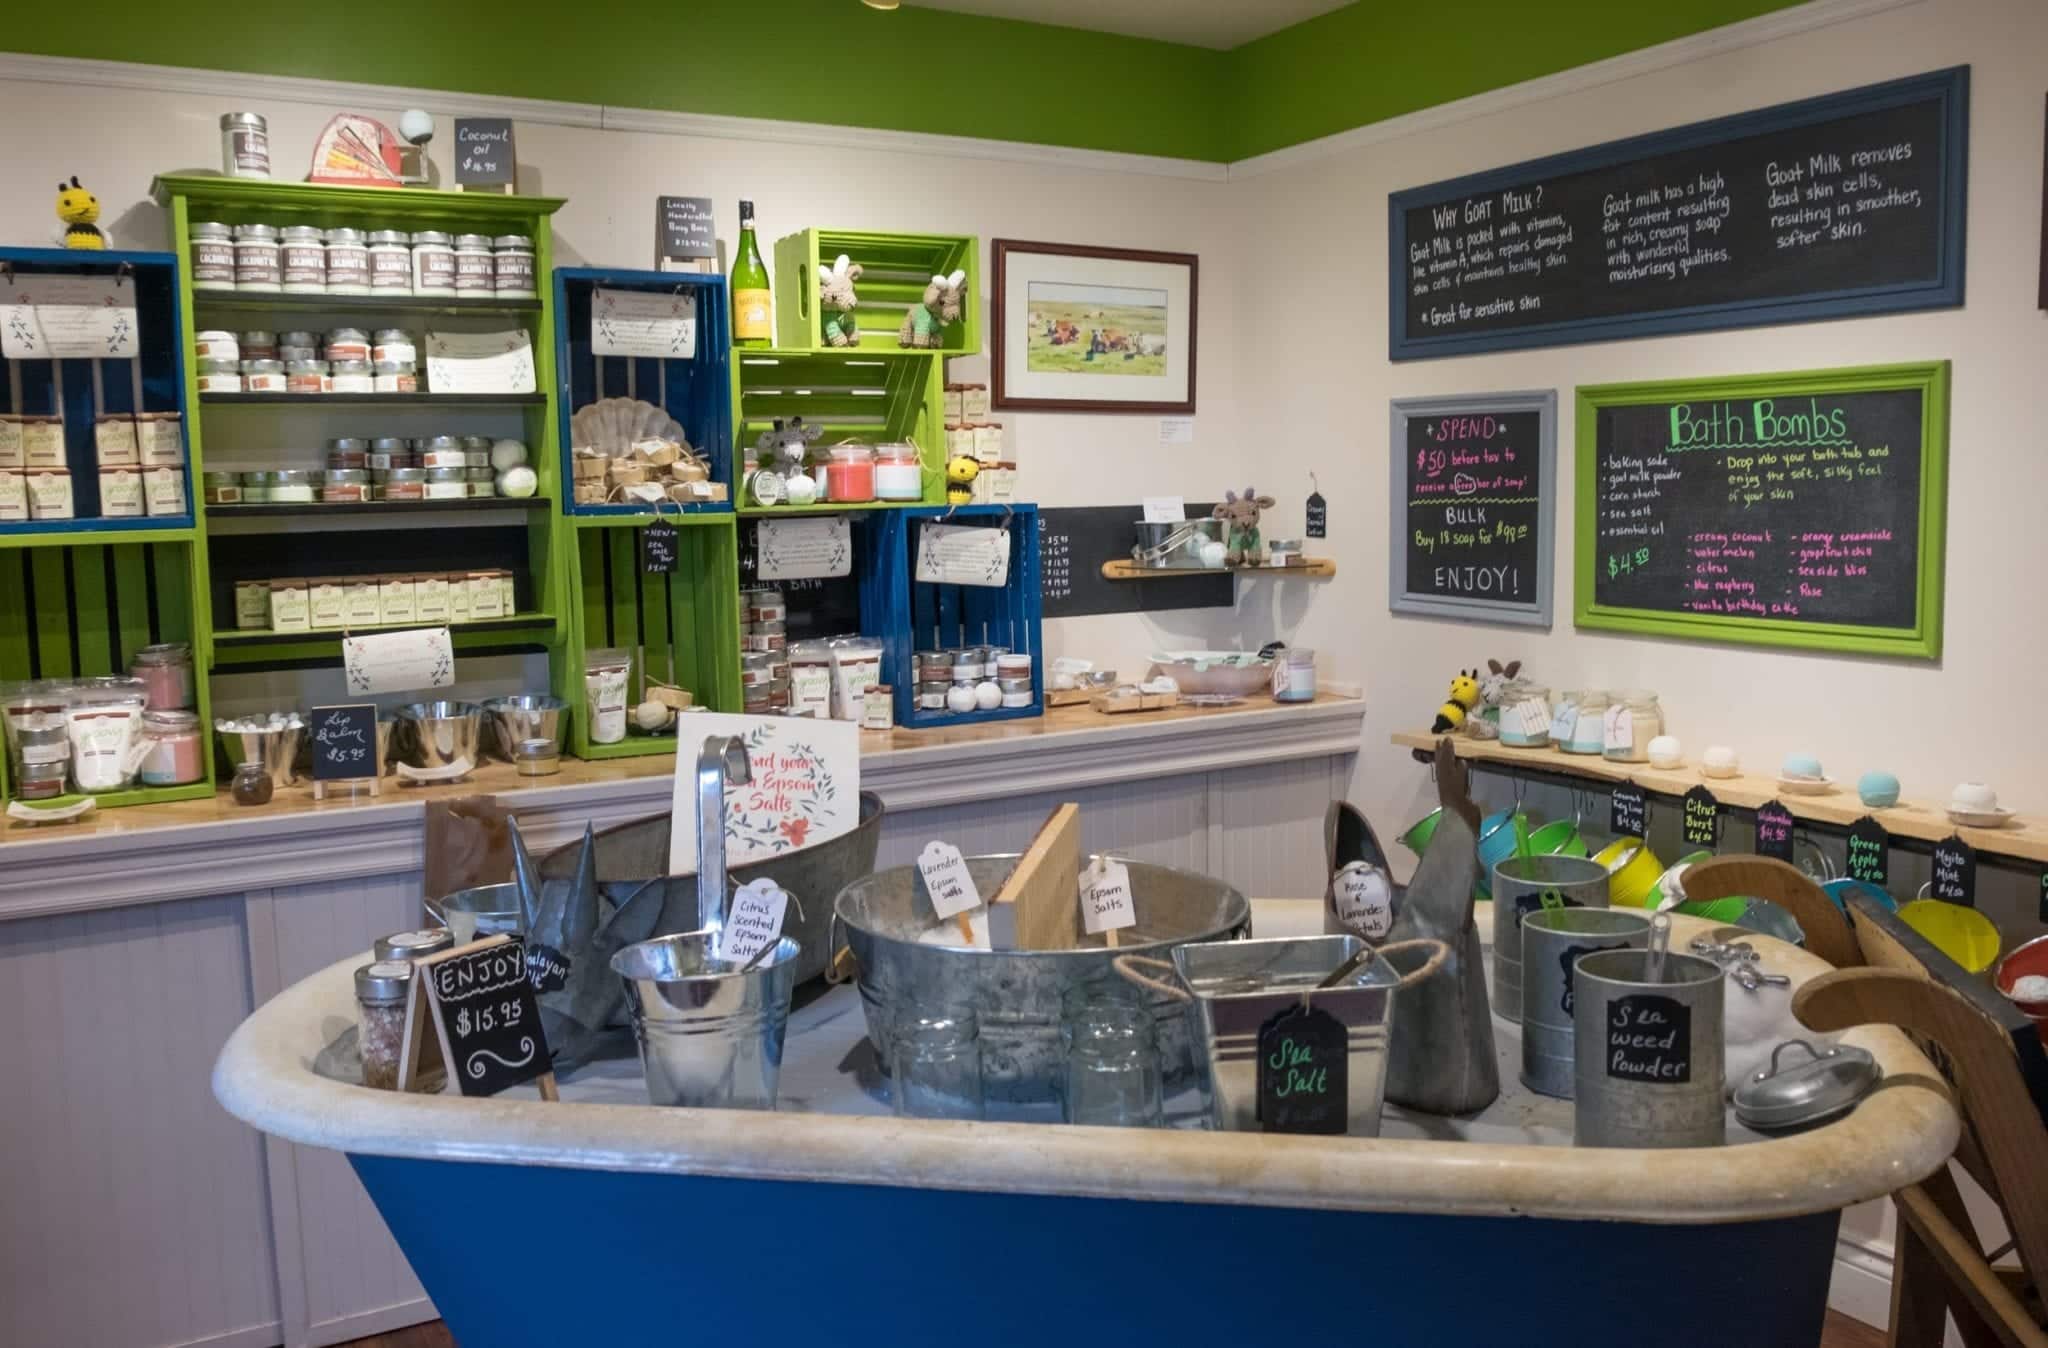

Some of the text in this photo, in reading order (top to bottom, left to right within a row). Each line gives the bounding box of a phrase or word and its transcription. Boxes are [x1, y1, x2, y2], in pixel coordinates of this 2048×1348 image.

[459, 127, 508, 142] Coconut
[1766, 142, 1912, 187] Goat Milk removes
[1603, 170, 1724, 217] Goat milk has a high
[1768, 172, 1882, 209] dead skin cells,
[1602, 196, 1730, 234] fat content resulting
[1771, 188, 1922, 229] resulting in smoother,
[1456, 236, 1464, 249] is
[1500, 223, 1521, 238] with
[1607, 238, 1616, 249] in
[1650, 224, 1688, 241] creamy
[1696, 216, 1721, 234] soap
[1777, 230, 1821, 249] softer
[1608, 239, 1689, 266] with wonderful
[1609, 261, 1676, 283] moisturizing
[1520, 295, 1541, 311] skin
[1436, 416, 1496, 441] SPEND
[1670, 398, 1847, 447] Bath Bombs
[1416, 449, 1446, 473] $50
[1451, 449, 1480, 466] before
[1504, 446, 1516, 461] to
[1609, 454, 1643, 473] baking
[1728, 444, 1889, 475] Drop into your bath tub and
[1477, 477, 1490, 489] bar
[1493, 475, 1503, 489] of
[1728, 474, 1760, 488] enjoy
[1767, 469, 1785, 482] the
[1824, 465, 1852, 481] silky
[1858, 462, 1882, 475] feel
[1609, 492, 1629, 502] corn
[1728, 488, 1794, 508] of your skin
[1446, 506, 1486, 525] BULK
[1609, 504, 1652, 519] sea salt
[1651, 520, 1664, 535] oil
[1415, 528, 1492, 555] Buy 18 soap for
[1694, 532, 1728, 548] creamy
[1696, 561, 1728, 574] citrus
[1434, 565, 1519, 595] ENJOY!
[325, 710, 351, 727] Lip
[316, 726, 366, 745] Balm
[763, 769, 816, 794] Epsom
[750, 791, 792, 812] Salts
[1686, 797, 1716, 816] Citrus
[1685, 815, 1713, 831] Burst
[1849, 834, 1881, 851] Green
[922, 856, 960, 876] Lavender
[1849, 853, 1878, 870] Apple
[1936, 867, 1960, 883] Mint
[1090, 885, 1123, 902] Epsom
[740, 900, 771, 915] Citrus
[734, 914, 776, 932] Scented
[735, 928, 767, 943] Epsom
[441, 950, 521, 993] ENJOY
[456, 998, 522, 1038] $15.95
[1613, 1005, 1667, 1027] Sea
[1611, 1029, 1676, 1049] weed
[1270, 1037, 1312, 1069] Sea
[1611, 1049, 1686, 1077] Powder
[1276, 1066, 1327, 1097] Salt
